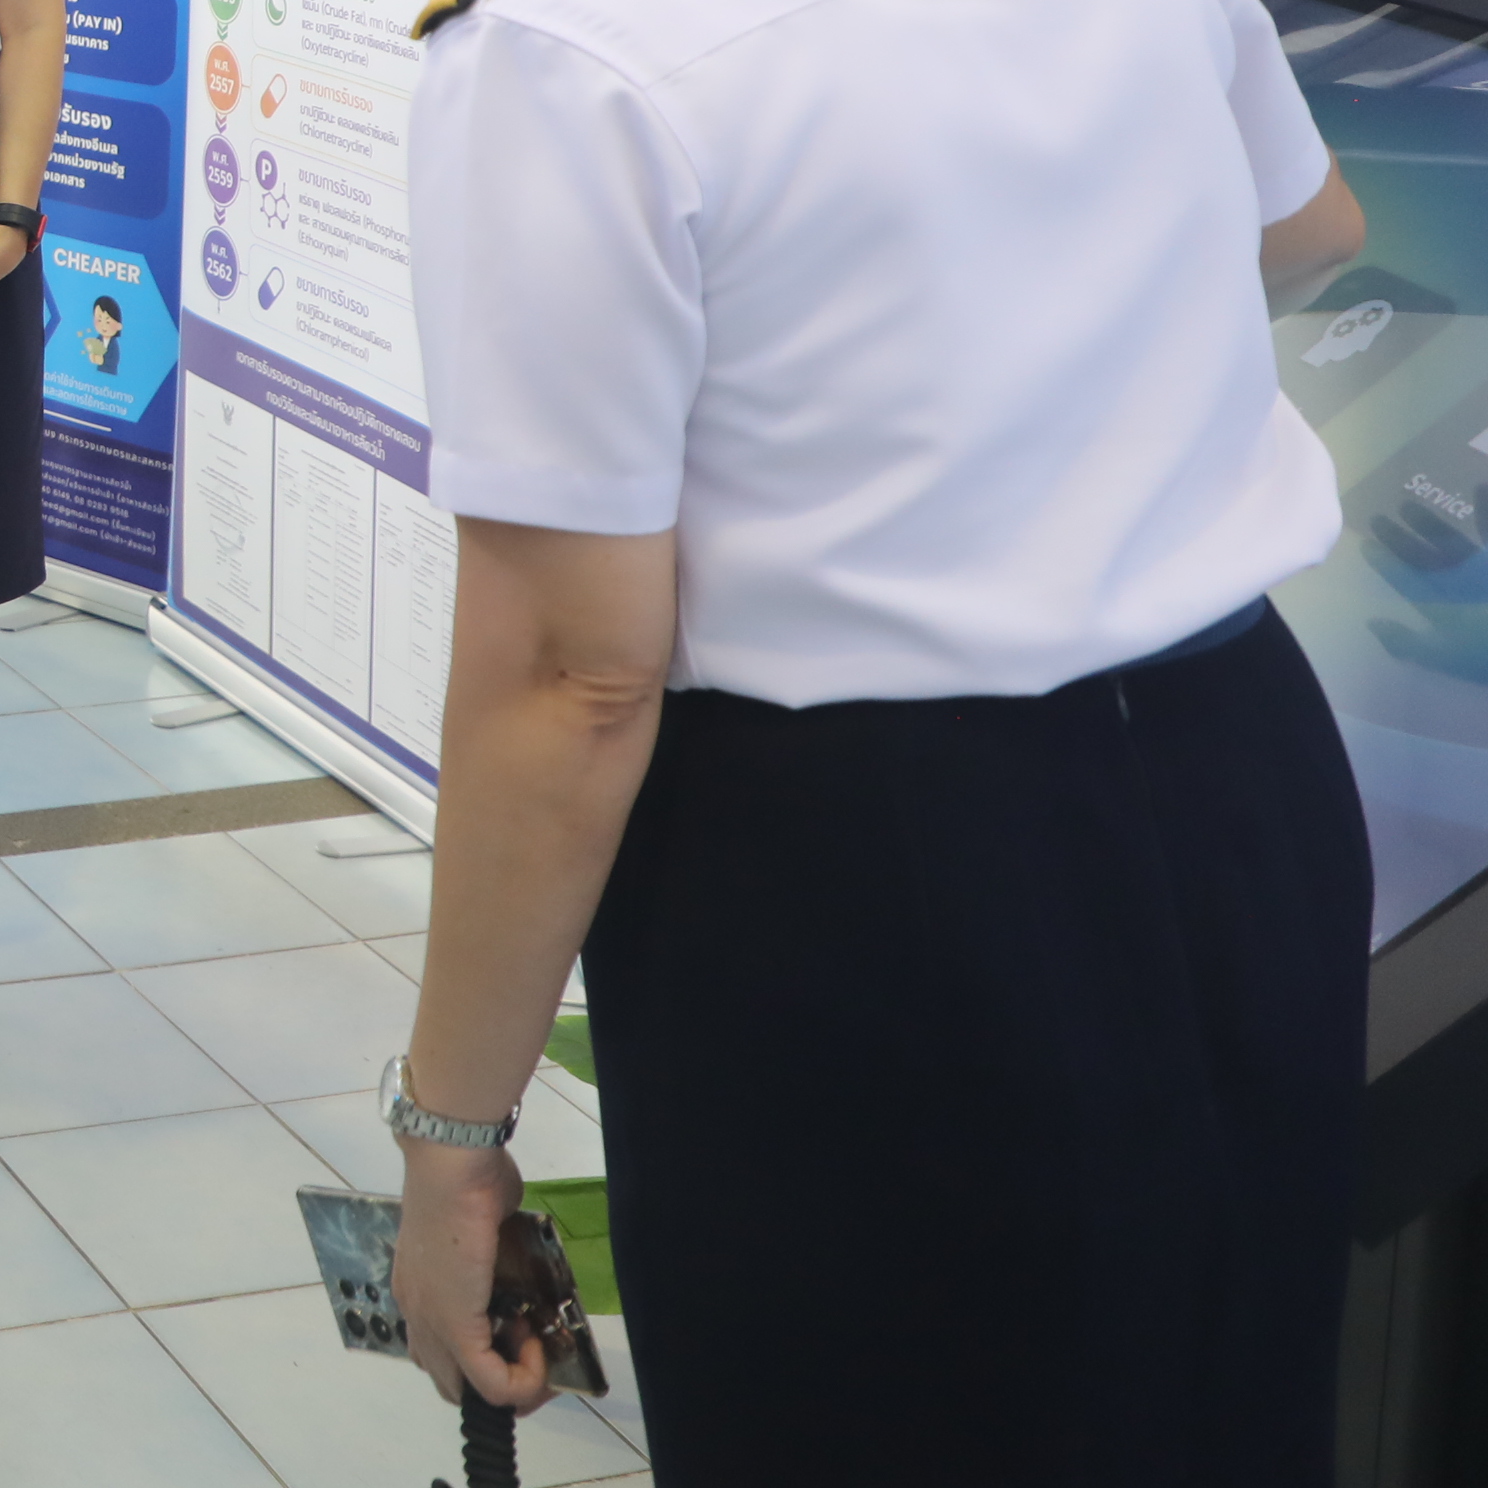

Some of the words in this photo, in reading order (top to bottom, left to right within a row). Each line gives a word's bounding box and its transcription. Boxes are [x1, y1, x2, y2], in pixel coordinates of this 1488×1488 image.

[73, 10, 102, 28] (PAY
[103, 16, 123, 35] IN)
[321, 0, 349, 20] (Crude
[302, 35, 369, 68] (Oxytetracycline)
[214, 59, 230, 72] พ.ศ.
[210, 73, 234, 96] 2557
[300, 79, 373, 113] ขยายการรับรอง
[60, 103, 112, 130] รับรอง
[54, 130, 118, 155] ดส่งทางอีเมล
[300, 120, 373, 158] (Chlortetracycline)
[212, 151, 229, 166] พ.ศ.
[261, 158, 272, 181] P
[44, 171, 85, 188] งเอกสาร
[208, 165, 233, 188] 2559
[299, 169, 372, 206] ขยายการรับรอง
[211, 243, 228, 258] พ.ศ.
[298, 229, 349, 262] (Ethoxyquin)
[54, 248, 141, 284] CHEAPER
[207, 257, 232, 282] 2562
[297, 276, 369, 318] ขยายการรับรอง
[297, 317, 369, 363] (Chloramphenicol)
[44, 372, 134, 403] ดค่าใช้จ่ายการเดินทาง
[1404, 473, 1474, 520] Service
[42, 498, 109, 525] eed@gmail.com
[42, 513, 98, 536] r@gmail.com
